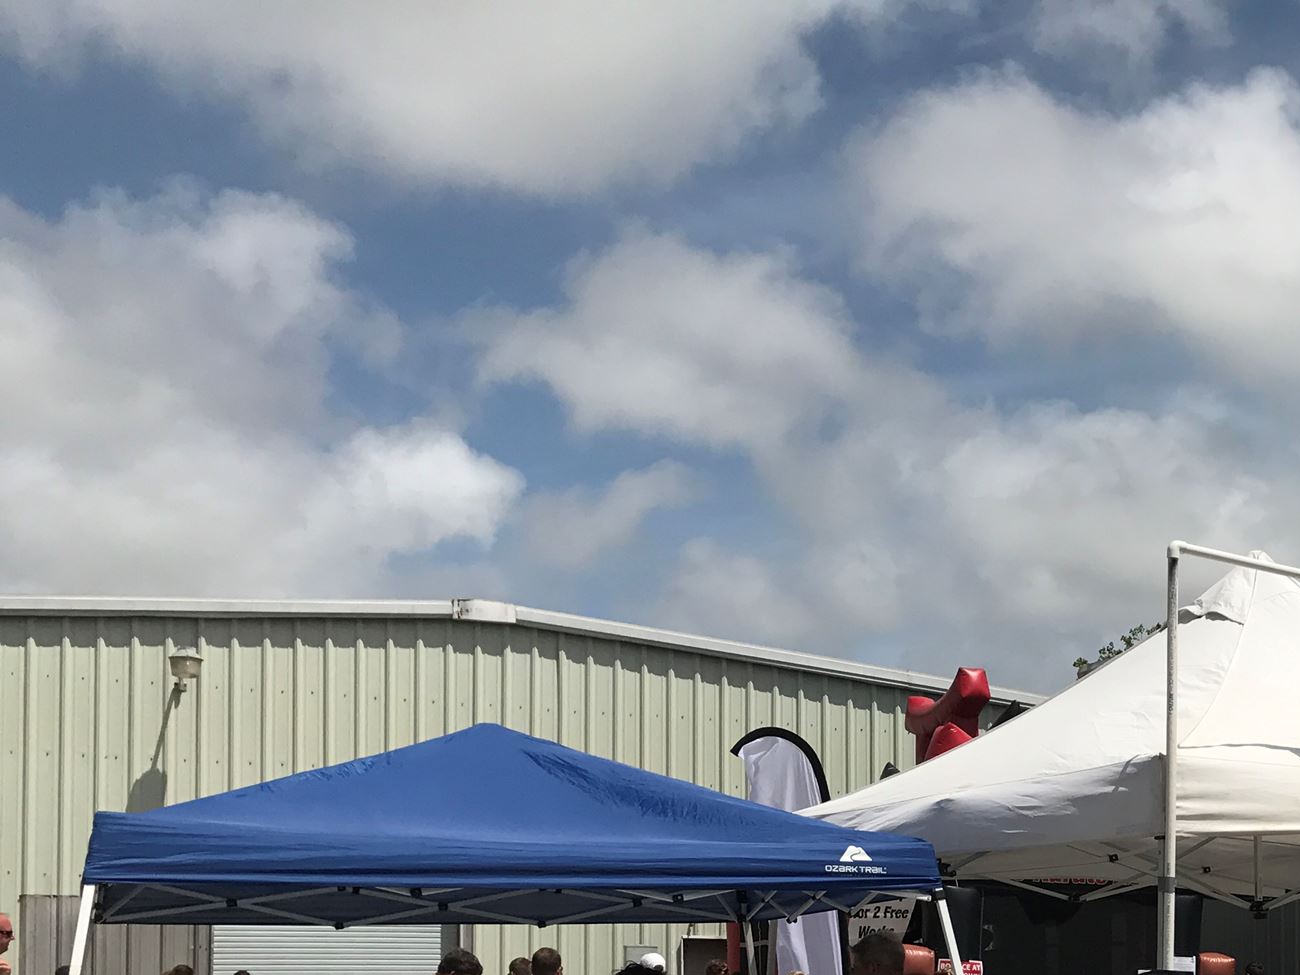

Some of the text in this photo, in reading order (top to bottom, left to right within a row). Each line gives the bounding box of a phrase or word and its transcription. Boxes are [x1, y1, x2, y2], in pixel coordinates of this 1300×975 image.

[824, 864, 887, 874] OZARK TRAIL
[873, 906, 881, 919] 2
[883, 906, 909, 919] Free
[940, 962, 971, 971] BOCE
